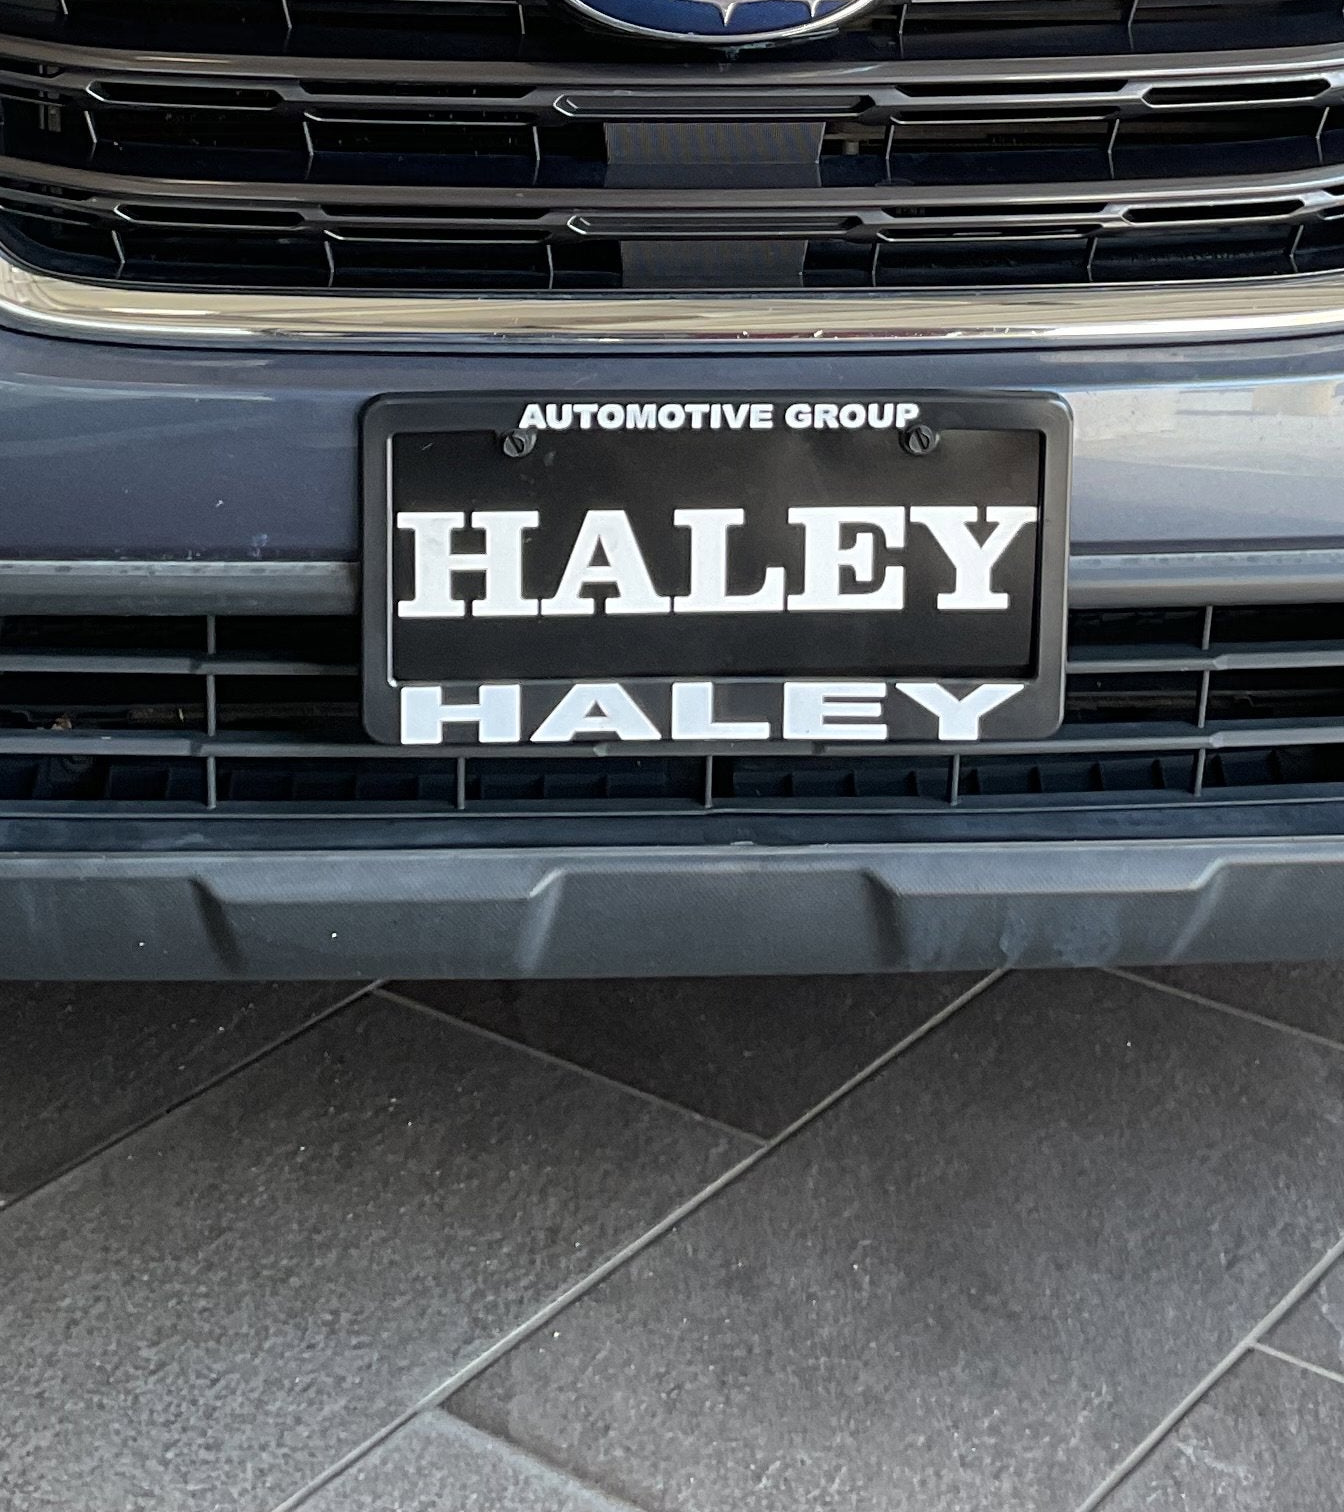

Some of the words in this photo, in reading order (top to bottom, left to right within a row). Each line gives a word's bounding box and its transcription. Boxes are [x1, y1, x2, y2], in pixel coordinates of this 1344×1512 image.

[518, 403, 773, 430] AUTOMOTIVE
[784, 402, 920, 429] GROUP
[396, 506, 1038, 618] HALEY
[399, 681, 1025, 745] HALEY
